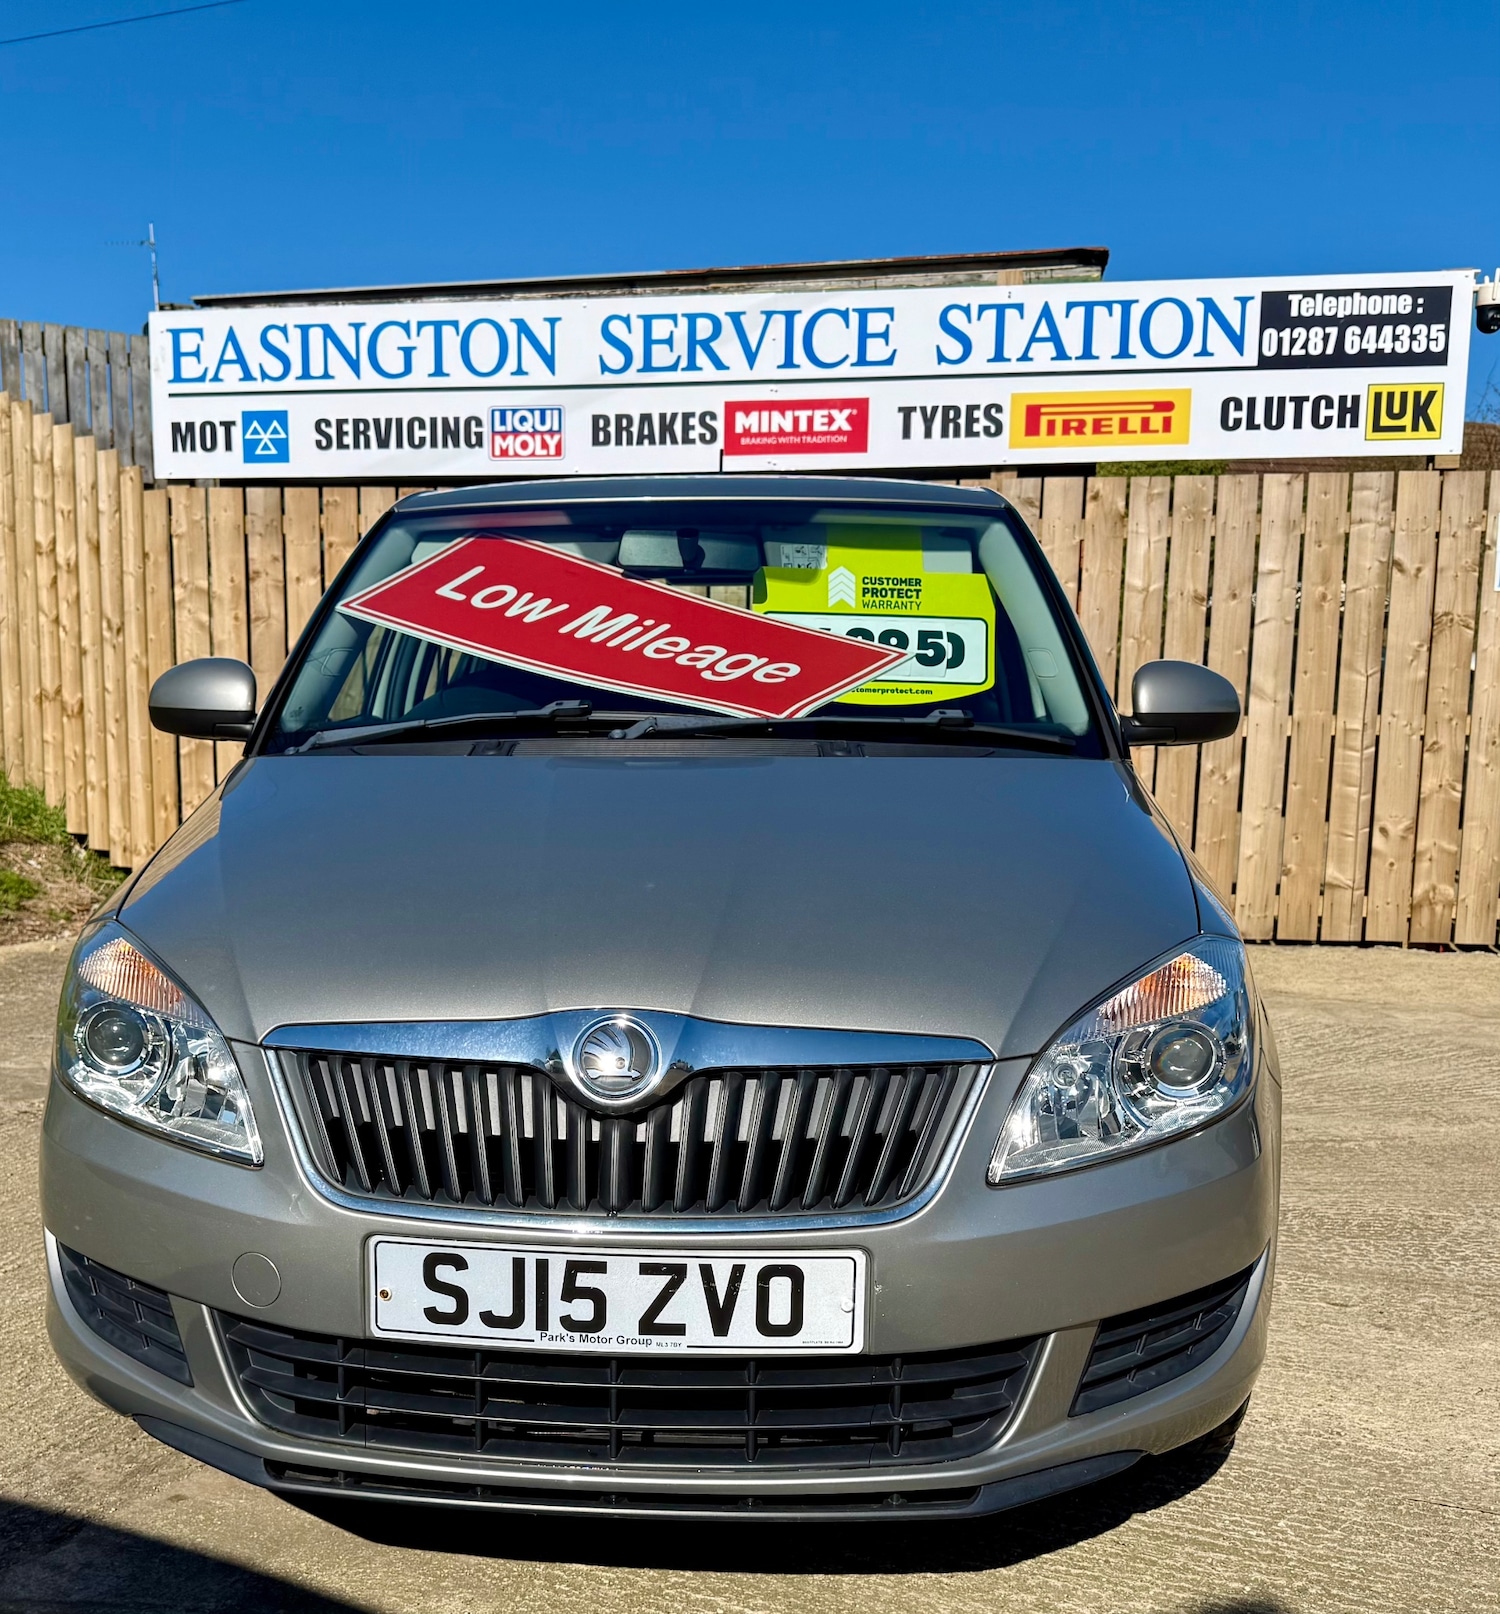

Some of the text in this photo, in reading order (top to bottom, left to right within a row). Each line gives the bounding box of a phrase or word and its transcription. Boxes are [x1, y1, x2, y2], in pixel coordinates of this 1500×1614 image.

[1288, 292, 1412, 319] Telephone
[168, 296, 1255, 384] EASINGTON SERVICE STATION
[1262, 322, 1447, 358] 01287 644335
[494, 409, 560, 433] LIQUI
[591, 410, 718, 447] BRAKES
[898, 403, 1003, 441] TYRES
[1025, 400, 1175, 438] PIRELLI
[1220, 395, 1360, 432] CLUTCH
[171, 420, 236, 453] MOT
[314, 415, 484, 451] SERVICING
[494, 433, 561, 457] MOLY
[740, 434, 848, 446] BRAKING WITH TRADITION
[861, 576, 923, 588] CUSTOMER
[861, 587, 923, 600] PROTECT
[861, 599, 923, 612] WARRANTY
[434, 565, 570, 623] Low
[558, 605, 801, 684] Mileage
[539, 1331, 653, 1348] Park's Motor Group
